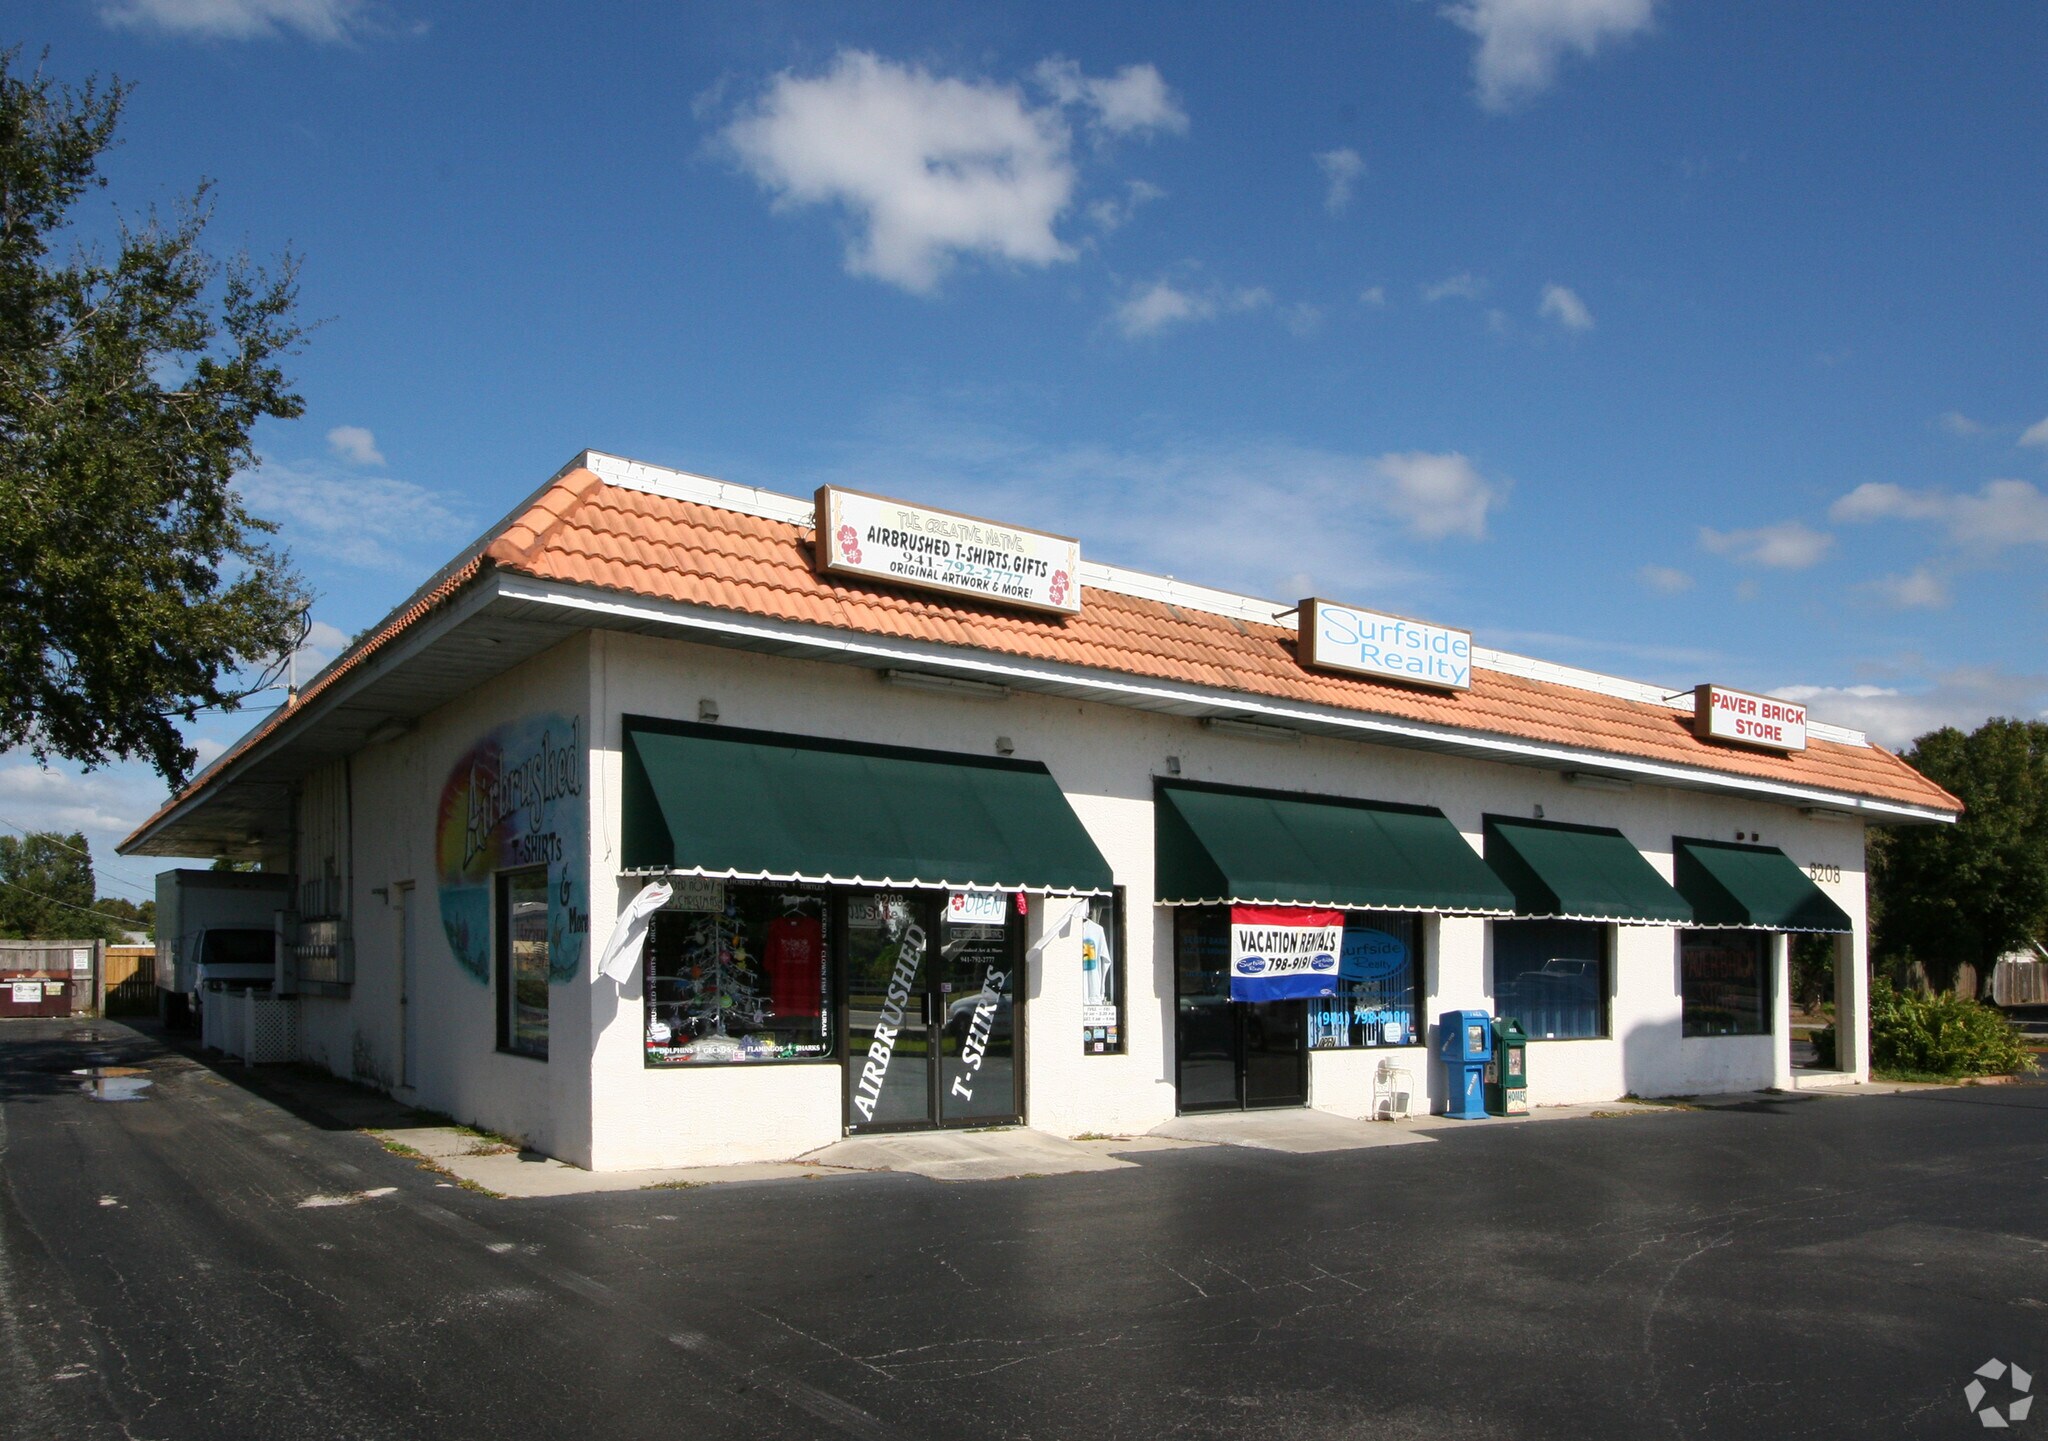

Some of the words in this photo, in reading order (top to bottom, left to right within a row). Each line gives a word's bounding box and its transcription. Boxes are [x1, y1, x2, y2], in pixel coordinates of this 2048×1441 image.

[897, 511, 922, 532] THE
[925, 519, 983, 544] CREATIVE
[986, 529, 1025, 553] NATIVE
[867, 525, 950, 557] AIRBRUSHED
[1013, 555, 1048, 578] GIFTS
[890, 561, 938, 581] ORIGINAL
[941, 573, 989, 592] ARTWORK
[992, 582, 999, 592] &
[1002, 584, 1033, 599] MORE!
[902, 551, 1024, 586] 941-792-2777
[1320, 608, 1468, 658] Surfside
[1360, 643, 1467, 685] Realty
[1712, 693, 1756, 716] PAVER
[1762, 703, 1805, 725] BRICK
[1735, 719, 1782, 741] STORE
[462, 714, 582, 871] Airbrushed
[1809, 862, 1841, 884] 8208
[866, 906, 898, 920] Suite
[874, 894, 903, 907] 8208
[965, 893, 1002, 916] OPEN
[1239, 930, 1297, 953] VACATION
[1300, 931, 1336, 953] RENTALS
[1268, 956, 1310, 972] 798-9191
[1353, 956, 1392, 970] Realty
[854, 924, 926, 1121] AIRBRUSHED
[952, 965, 1006, 1101] T-SHIRTS
[795, 1044, 821, 1052] SHARKS
